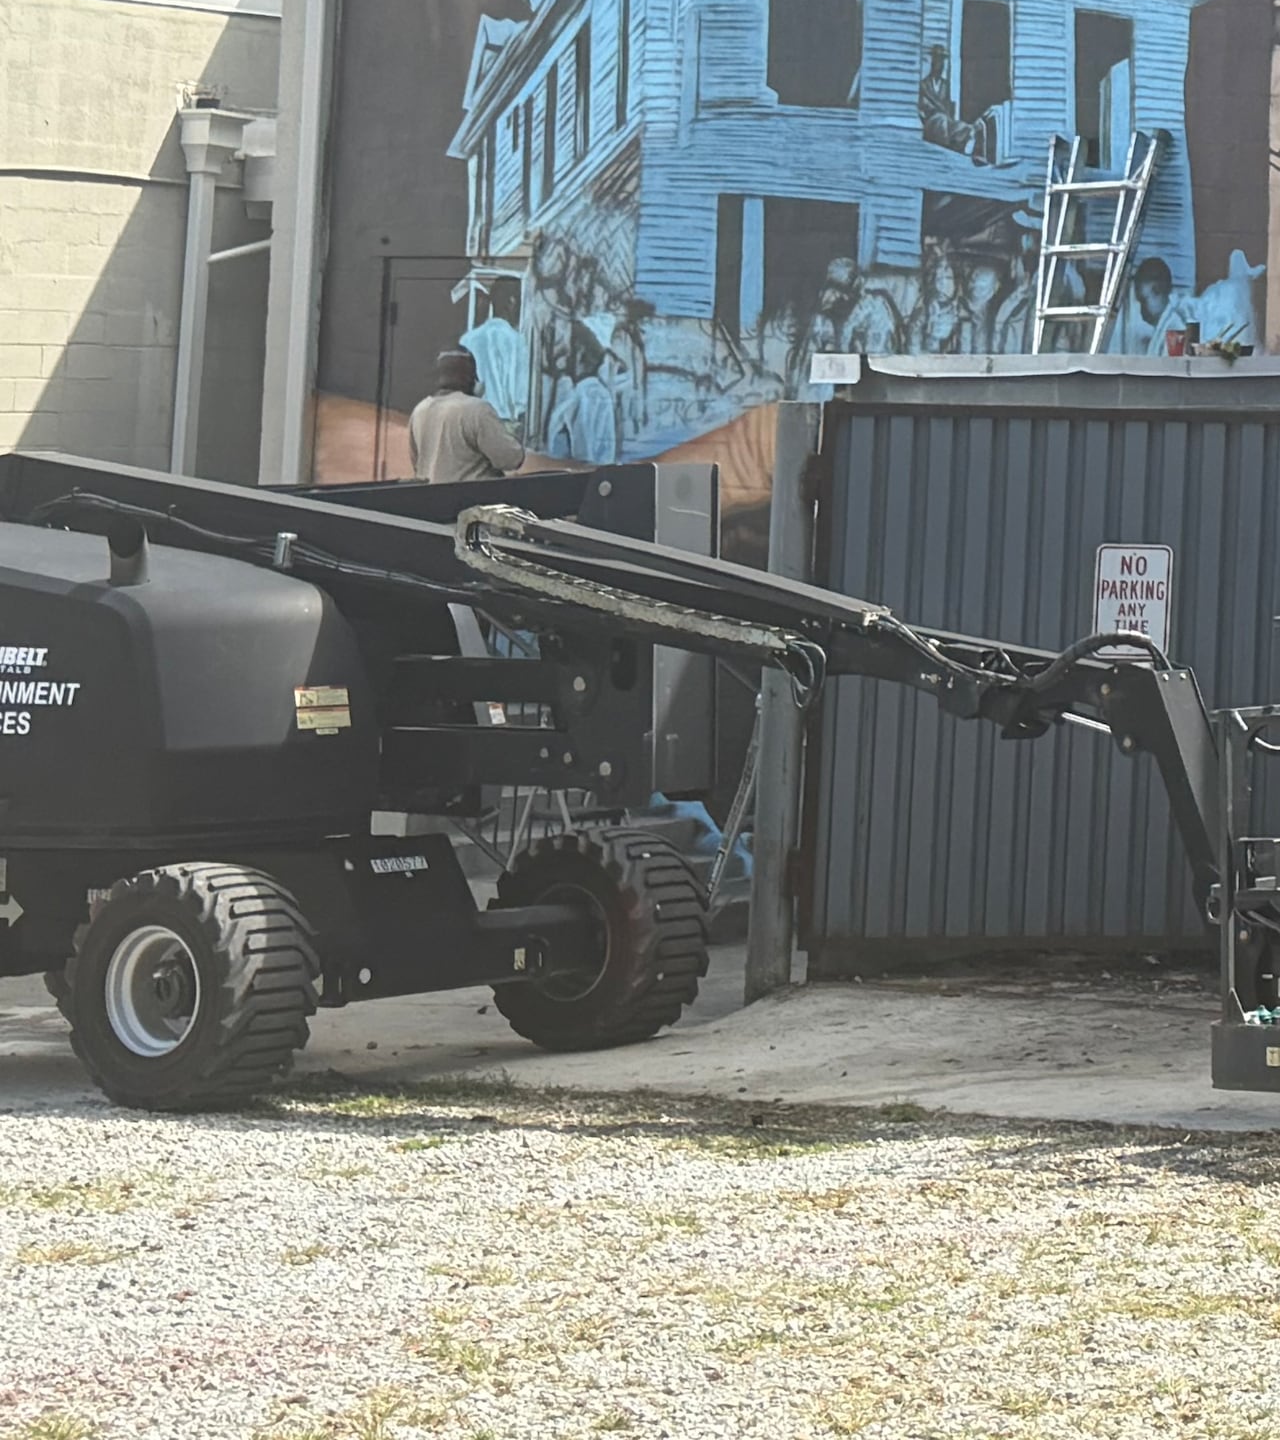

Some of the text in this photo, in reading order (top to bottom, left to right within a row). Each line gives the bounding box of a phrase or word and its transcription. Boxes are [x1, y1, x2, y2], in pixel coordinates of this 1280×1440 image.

[1120, 555, 1148, 576] NO
[1101, 579, 1166, 601] PARKING
[1117, 602, 1147, 617] ANY
[1113, 619, 1149, 635] TIME
